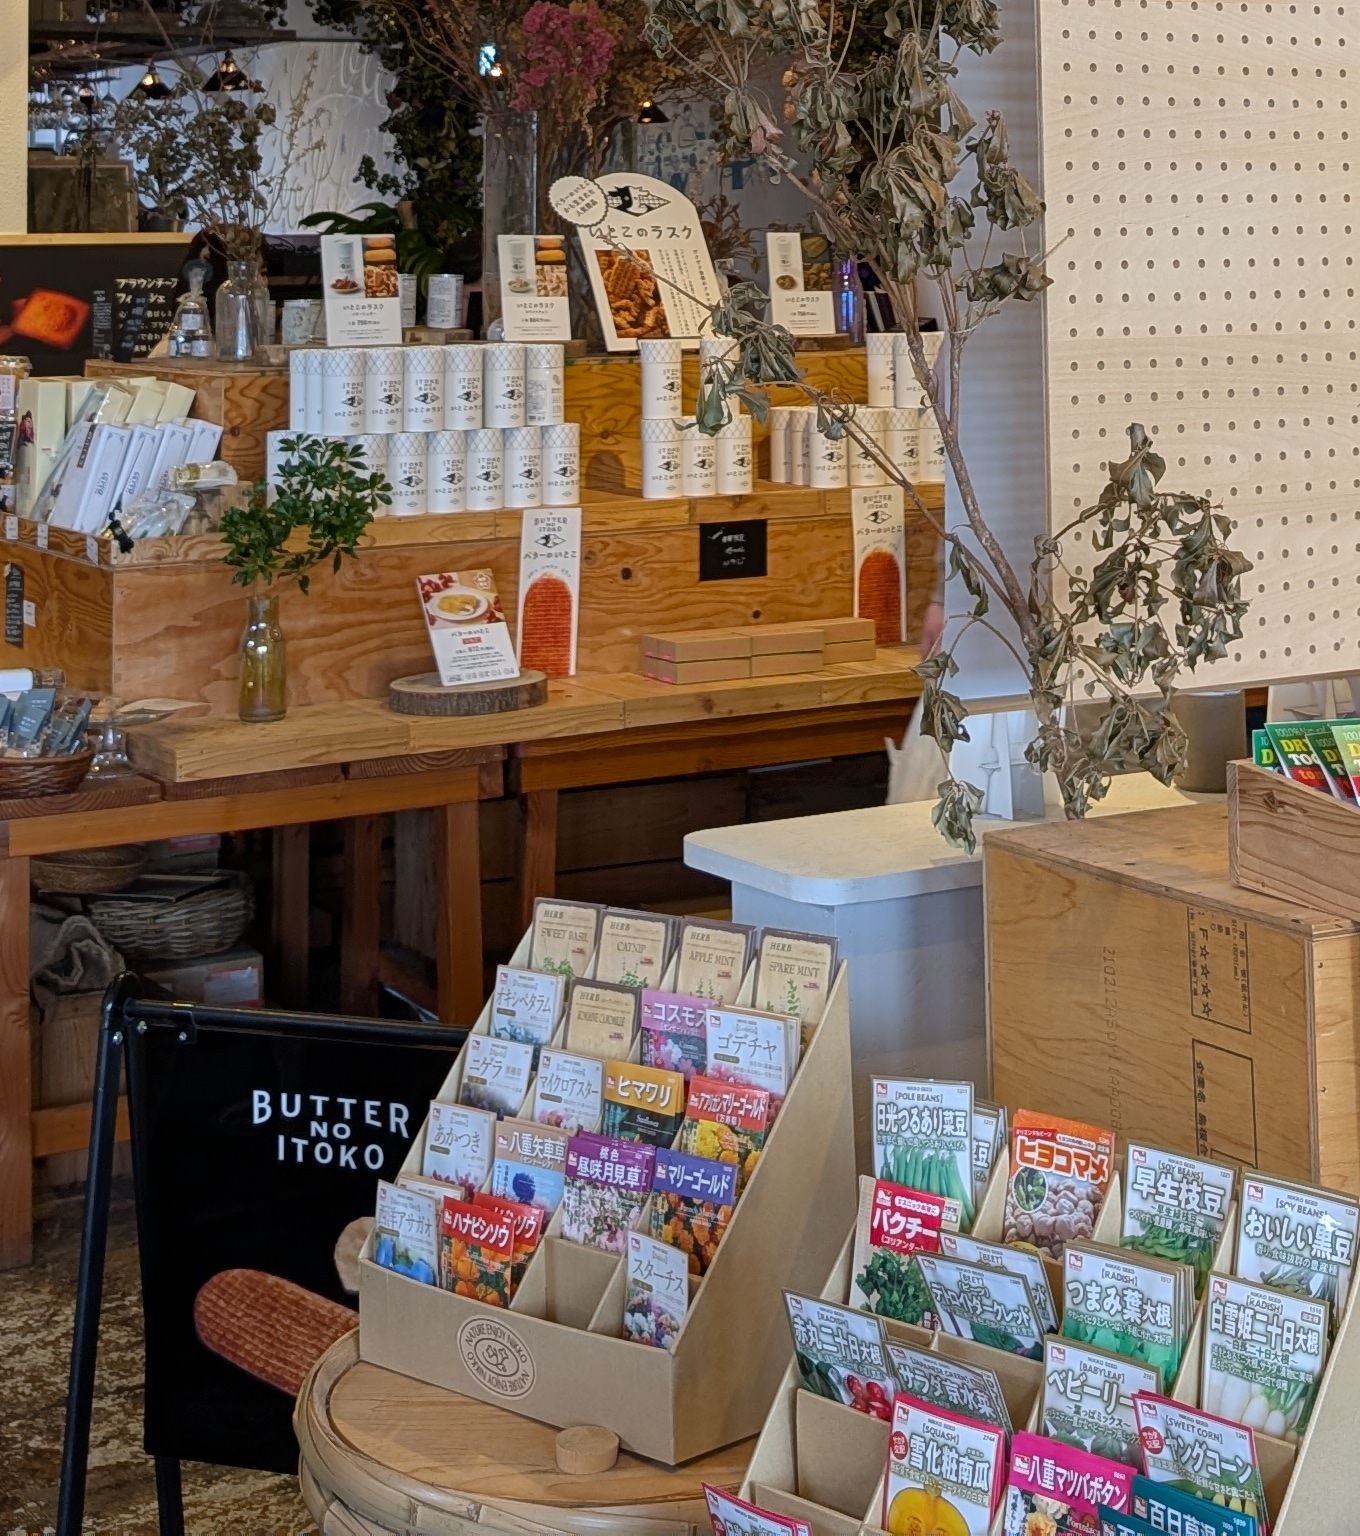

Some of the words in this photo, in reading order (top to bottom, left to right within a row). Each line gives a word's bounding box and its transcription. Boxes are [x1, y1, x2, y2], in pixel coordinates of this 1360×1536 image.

[543, 909, 565, 920] HERB
[609, 921, 631, 932] HERB
[690, 931, 711, 943] HERB
[770, 941, 793, 953] HERB
[796, 964, 821, 978] MINT
[579, 990, 601, 1002] HERB
[717, 1033, 778, 1060] ゴデチヤ
[469, 1056, 503, 1078] ニゲラ
[539, 1074, 599, 1099] マイクロアスター
[616, 1074, 673, 1108] ヒマワリ
[252, 1088, 410, 1138] BUTTER
[875, 1102, 968, 1138] 日光つるあり菜豆
[309, 1120, 351, 1140] NO
[433, 1126, 482, 1152] あかつき
[277, 1135, 385, 1170] ITOKO
[1016, 1136, 1109, 1184] ヒヨコマメ
[576, 1157, 641, 1188] 昼咲月見草
[667, 1163, 730, 1198] マリーゴールド
[1131, 1166, 1226, 1221] 早生枝豆
[452, 1211, 510, 1248] ハナビシソウ
[872, 1209, 938, 1240] パクチー
[1244, 1206, 1354, 1266] おいしい黒豆
[630, 1254, 687, 1297] スターチス
[1101, 1268, 1138, 1287] [RADISH]
[1066, 1279, 1173, 1331] つまみ葉大根
[792, 1314, 882, 1367] 赤丸二十日大根
[1210, 1298, 1320, 1356] 白雪姫二十日大根
[921, 1422, 960, 1445] [SQUASH]
[909, 1433, 990, 1492] 雪化粧南瓜
[1164, 1429, 1253, 1485] ヤングコーン
